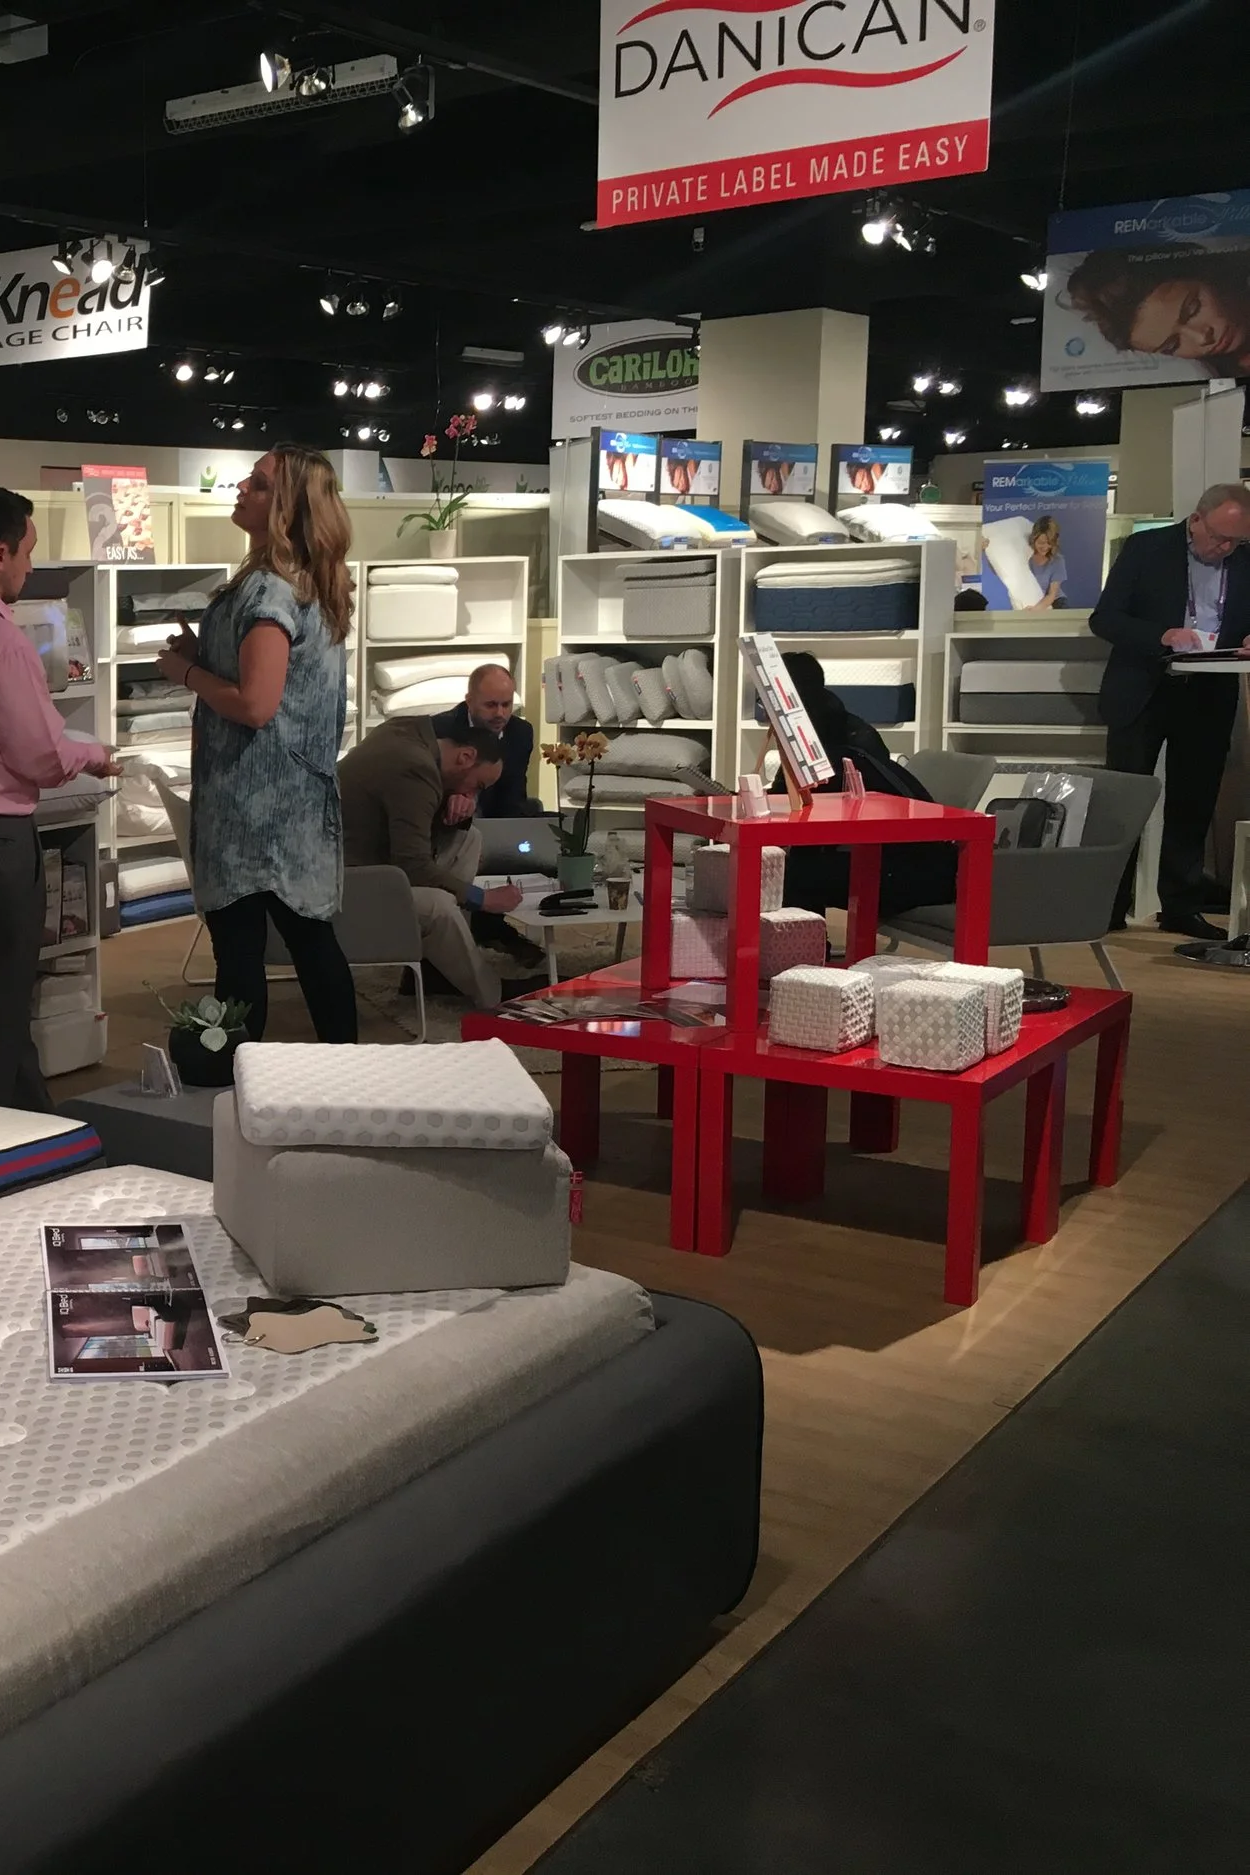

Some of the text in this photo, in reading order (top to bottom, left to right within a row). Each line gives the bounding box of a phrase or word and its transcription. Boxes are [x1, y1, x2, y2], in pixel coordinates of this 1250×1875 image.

[612, 134, 969, 214] PRIVATE LABEL MADE EASY
[51, 316, 143, 342] CHAIR
[569, 412, 613, 423] SOFTEST
[615, 408, 662, 420] BEDDING
[664, 406, 680, 415] ON
[106, 546, 126, 560] EASY
